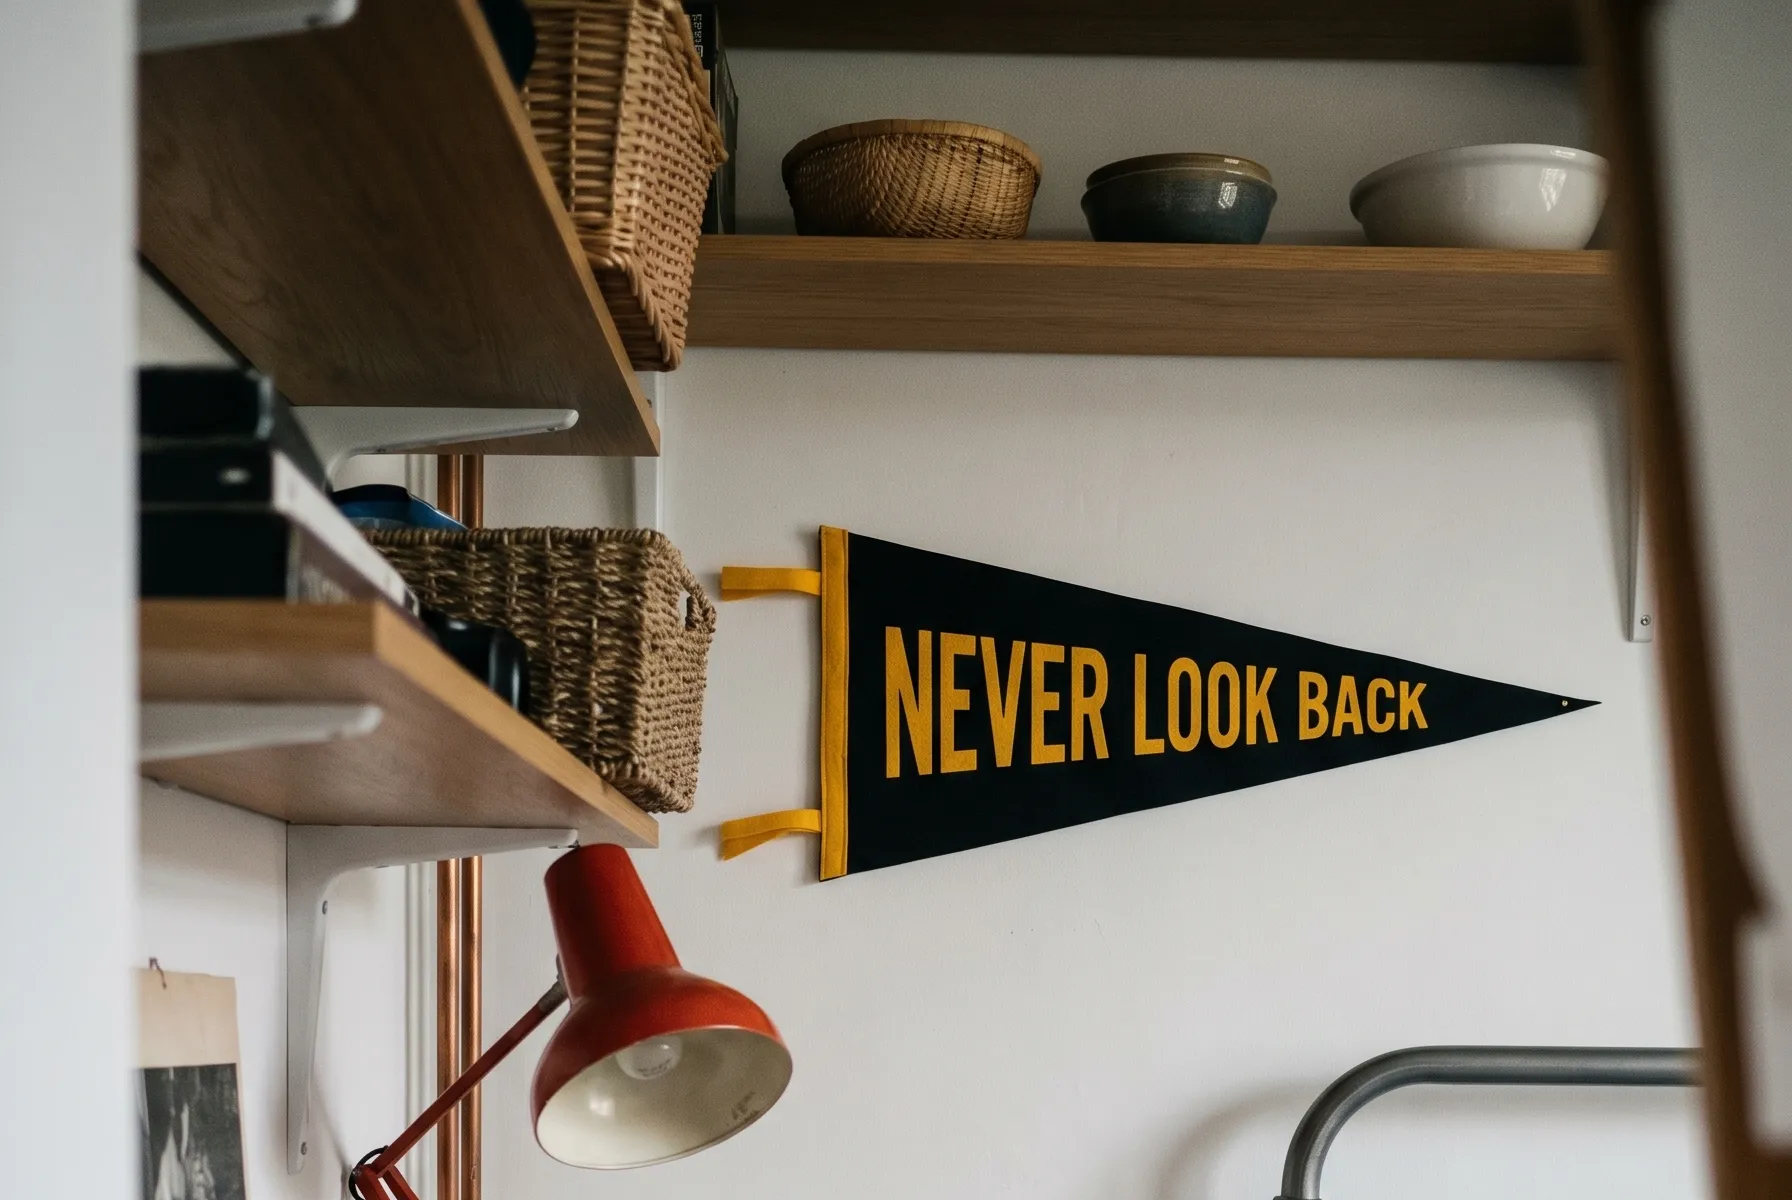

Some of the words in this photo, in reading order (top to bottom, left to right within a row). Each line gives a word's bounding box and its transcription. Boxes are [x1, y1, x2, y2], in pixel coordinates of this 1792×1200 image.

[885, 626, 1110, 779] NEVER
[1133, 653, 1279, 757] LOOK
[1298, 670, 1429, 741] BACK
